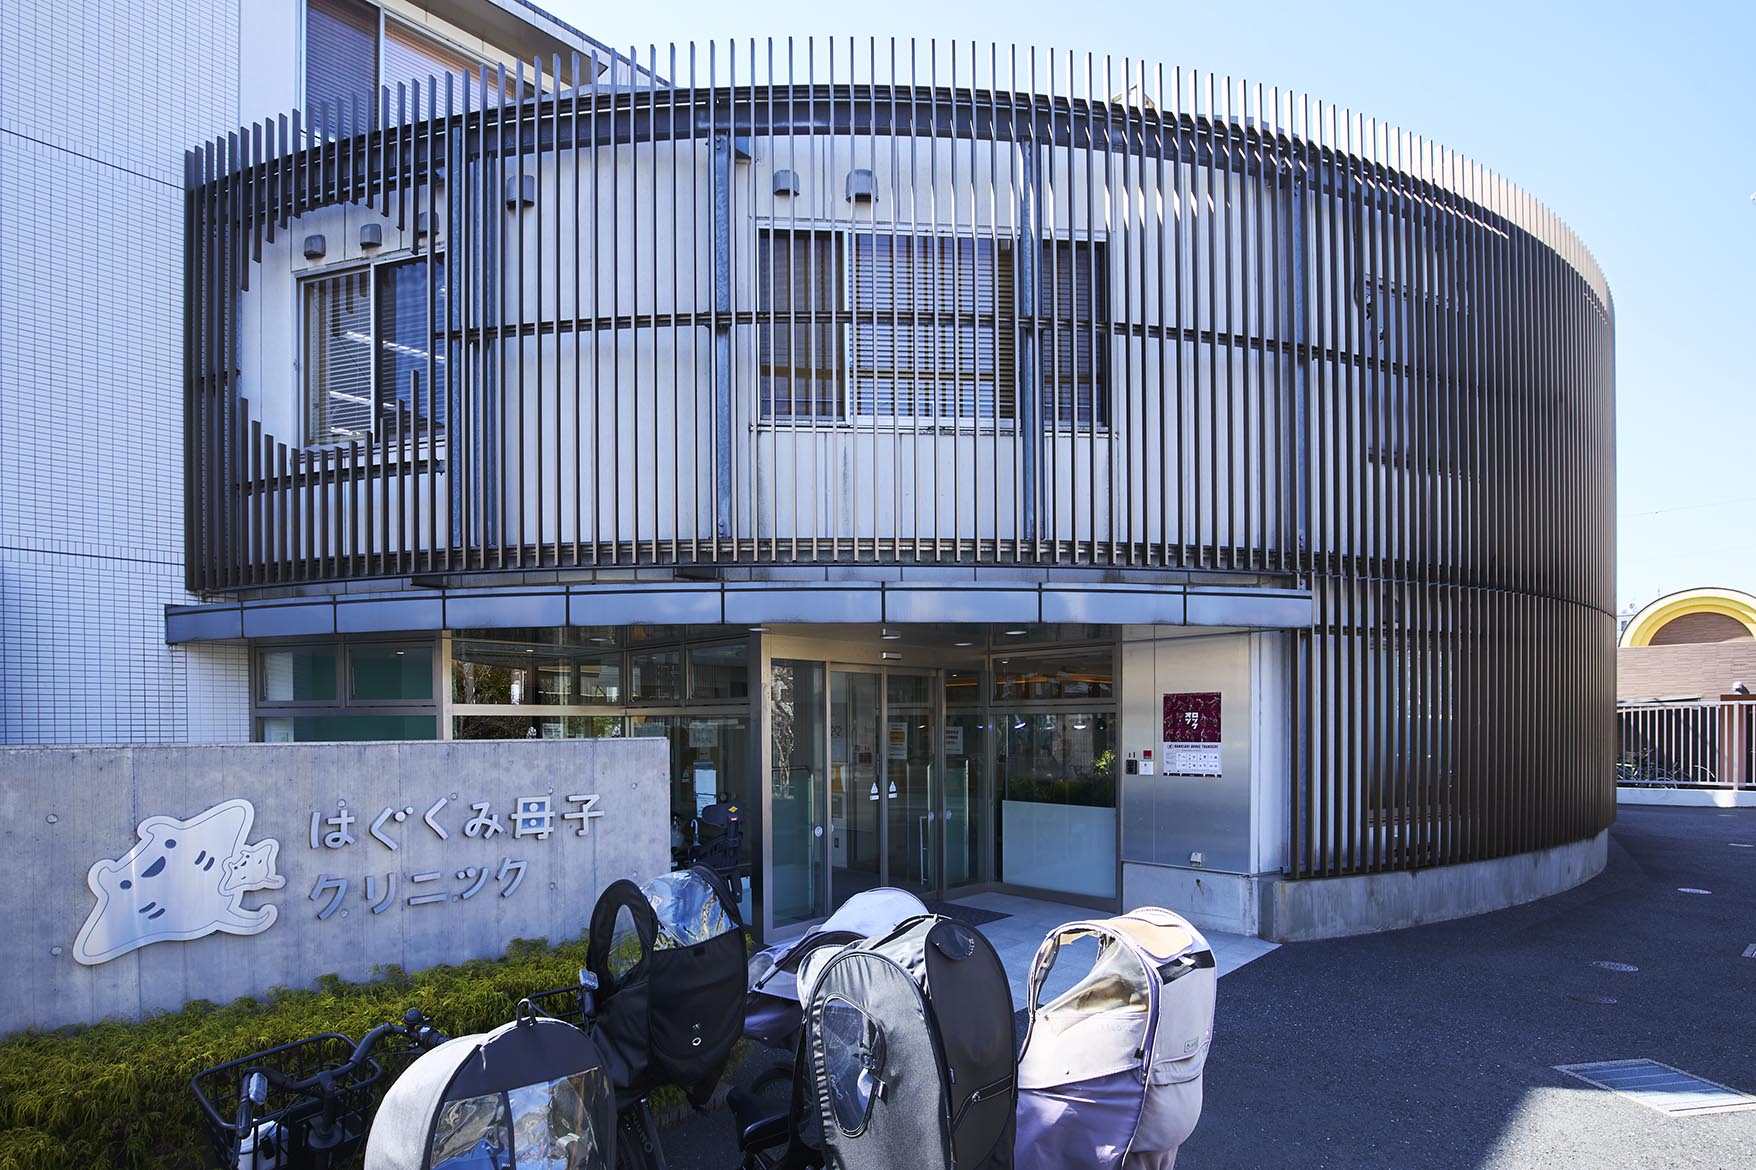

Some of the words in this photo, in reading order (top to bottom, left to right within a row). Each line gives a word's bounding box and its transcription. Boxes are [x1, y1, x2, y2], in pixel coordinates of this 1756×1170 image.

[309, 793, 605, 851] はぐくみ母子
[309, 857, 528, 920] クリニック
